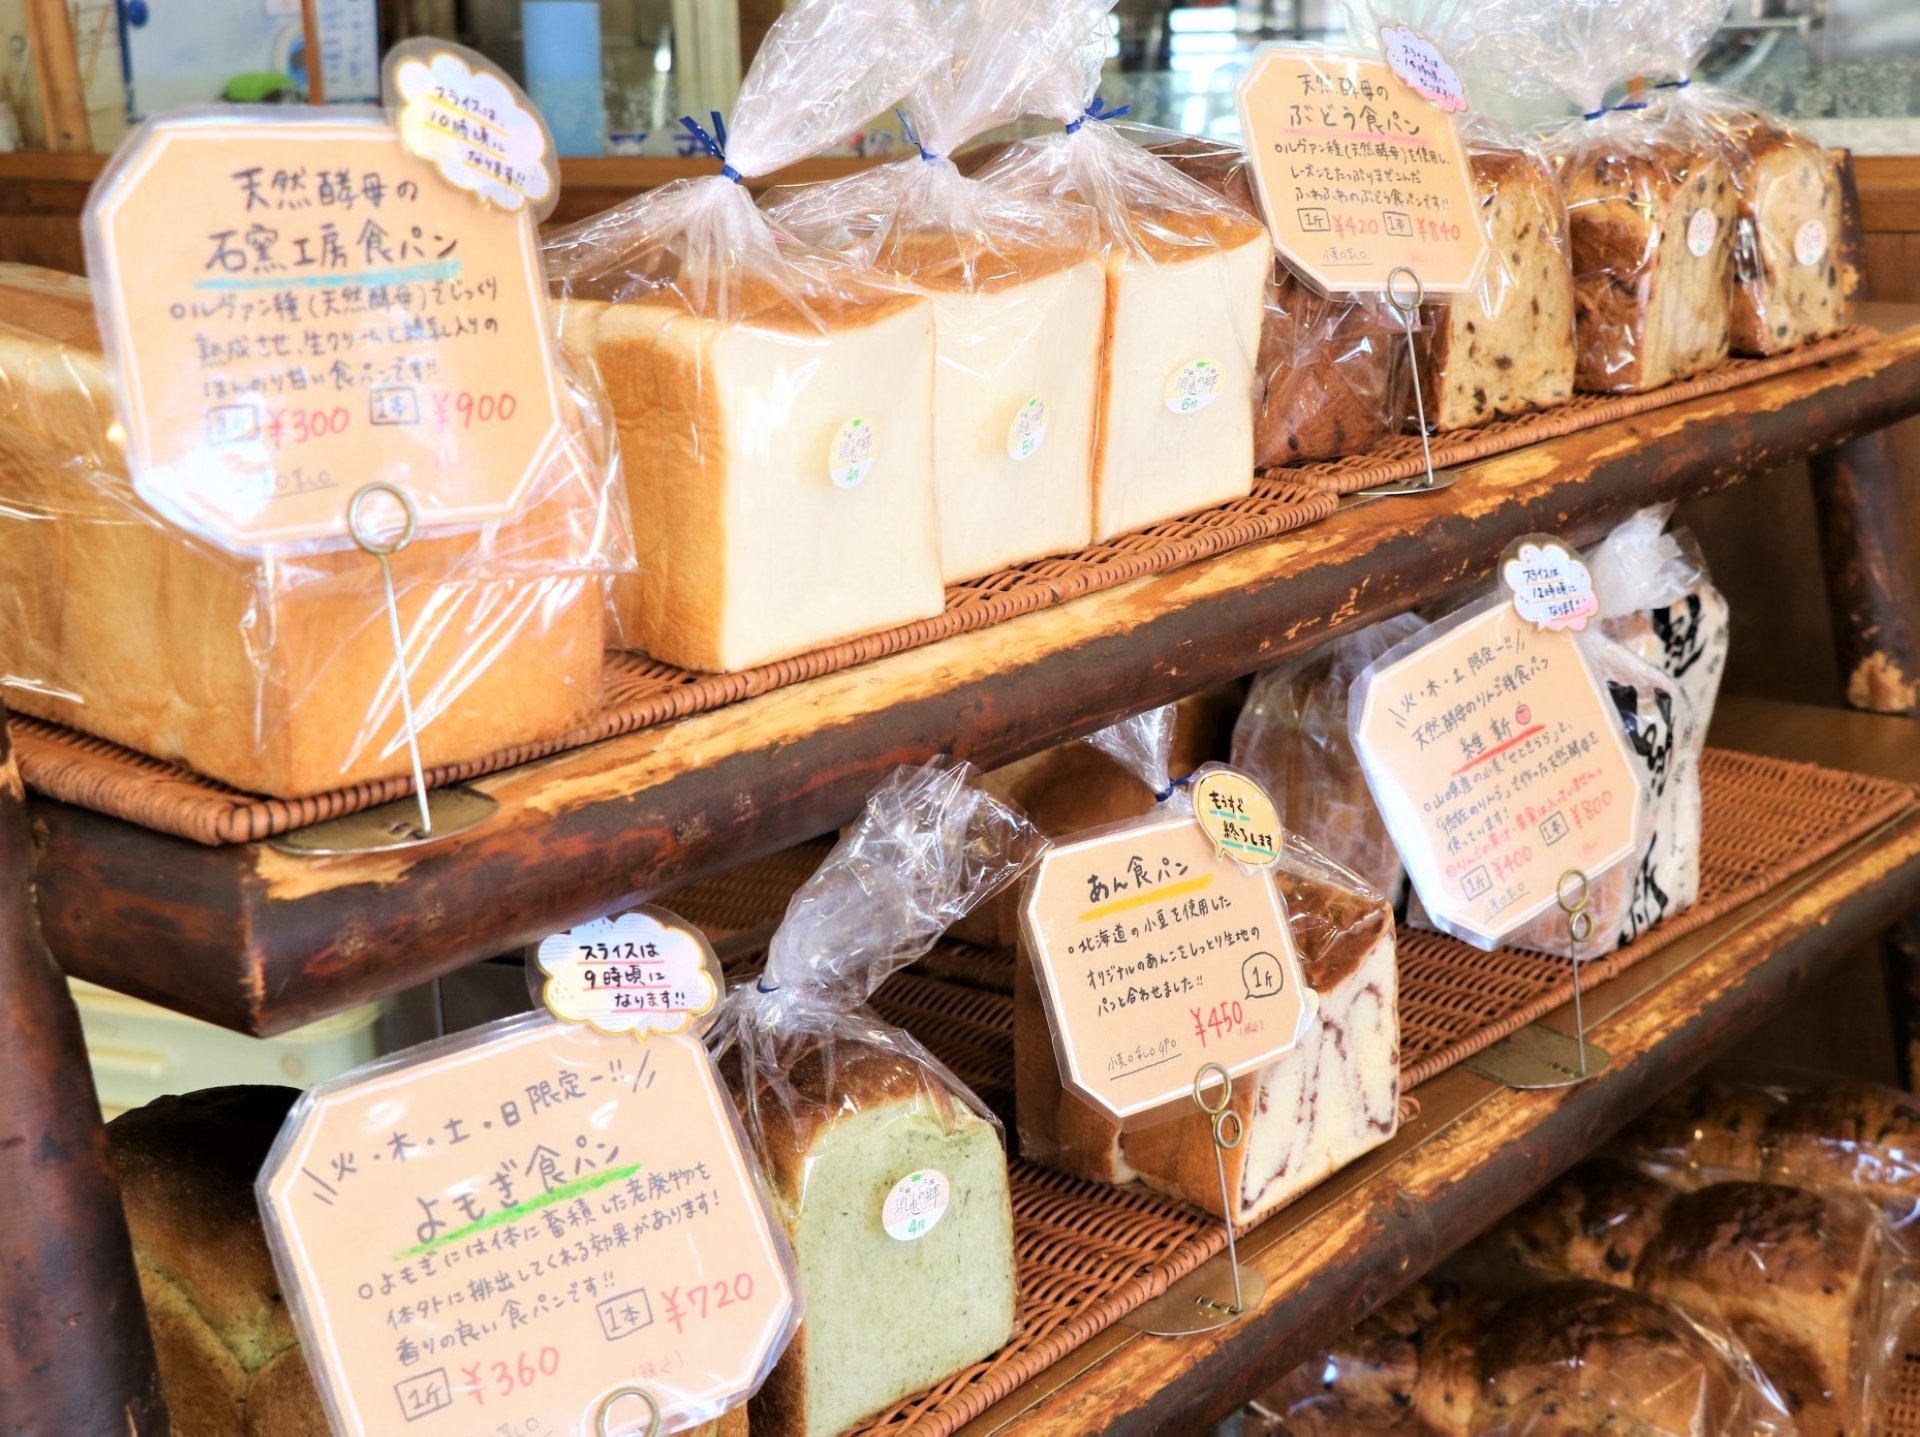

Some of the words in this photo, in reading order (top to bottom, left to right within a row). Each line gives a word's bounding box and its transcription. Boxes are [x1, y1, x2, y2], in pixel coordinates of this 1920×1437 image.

[1290, 104, 1420, 135] ぶどう食パン
[232, 166, 419, 212] 天然酵母の
[267, 406, 350, 449] ¥300
[430, 391, 518, 432] ¥900
[1209, 790, 1245, 814] もうすぐ
[1222, 819, 1274, 851] 終了します
[1087, 854, 1189, 904] あん食パン
[580, 940, 660, 962] スライスは
[1087, 925, 1261, 991] オリジナルのあんこをしっとり生地の
[584, 967, 666, 991] 9時頃に
[1190, 999, 1244, 1049] ¥450
[415, 1134, 622, 1246] よもぎ食パン
[660, 1270, 755, 1335] ¥720
[459, 1343, 561, 1406] ¥360
